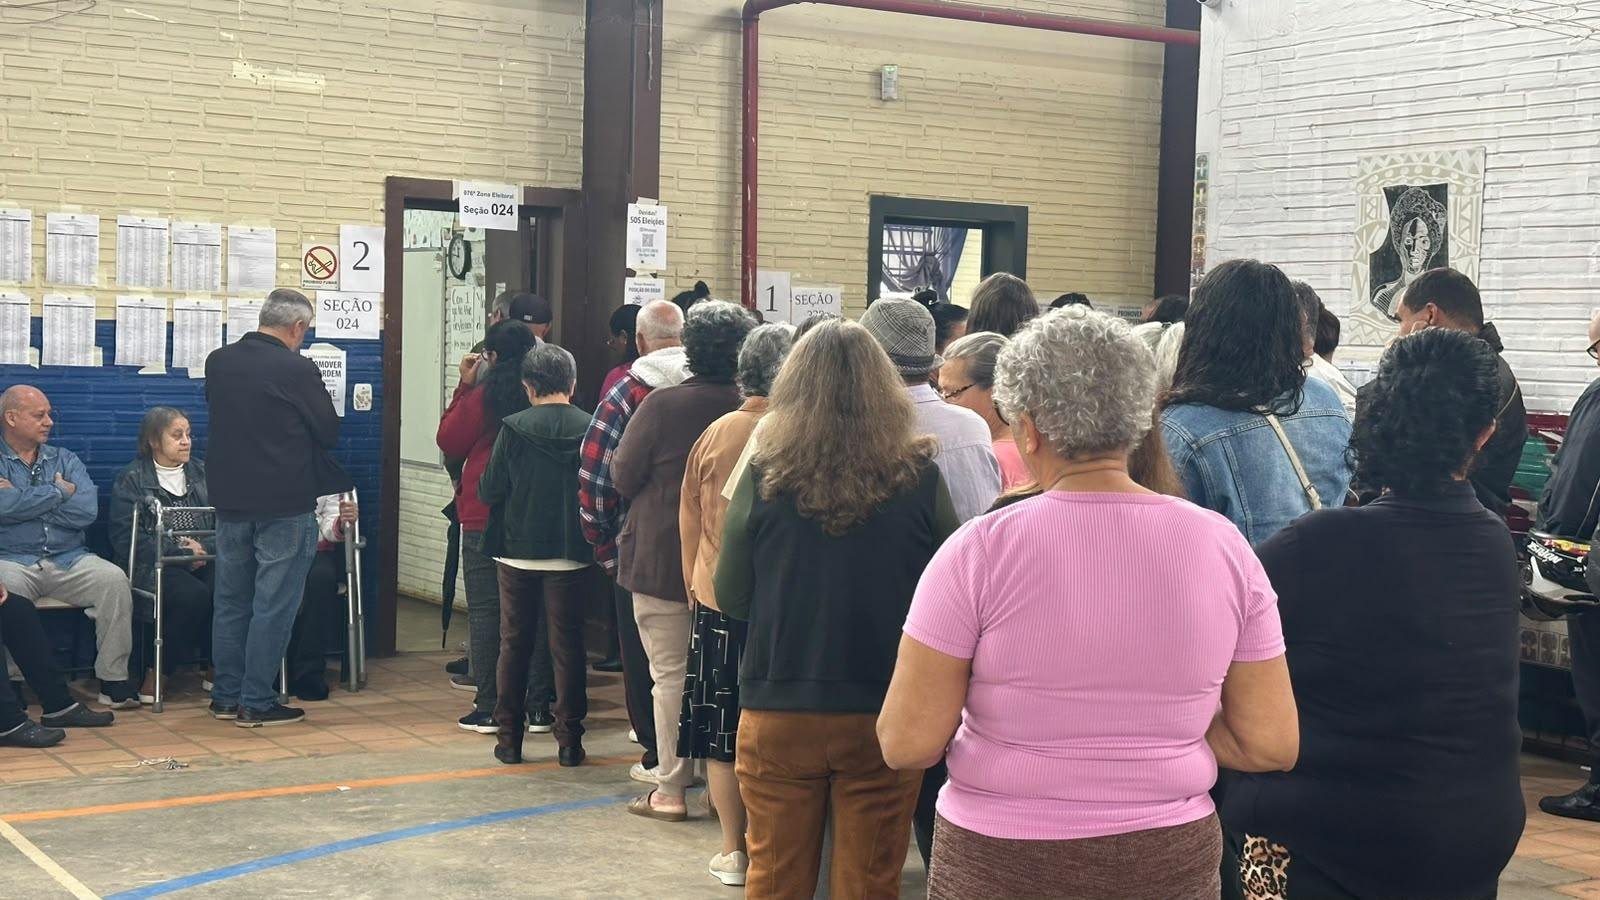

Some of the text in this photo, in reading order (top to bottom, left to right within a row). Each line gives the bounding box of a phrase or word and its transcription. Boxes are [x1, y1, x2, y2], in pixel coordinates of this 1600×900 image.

[464, 204, 514, 216] Seção 024
[642, 217, 664, 226] Eleições
[353, 241, 370, 270] 2
[324, 298, 372, 314] SEÇÃO
[766, 285, 778, 312] 1
[795, 292, 833, 307] SEÇÃO
[337, 318, 359, 329] 024
